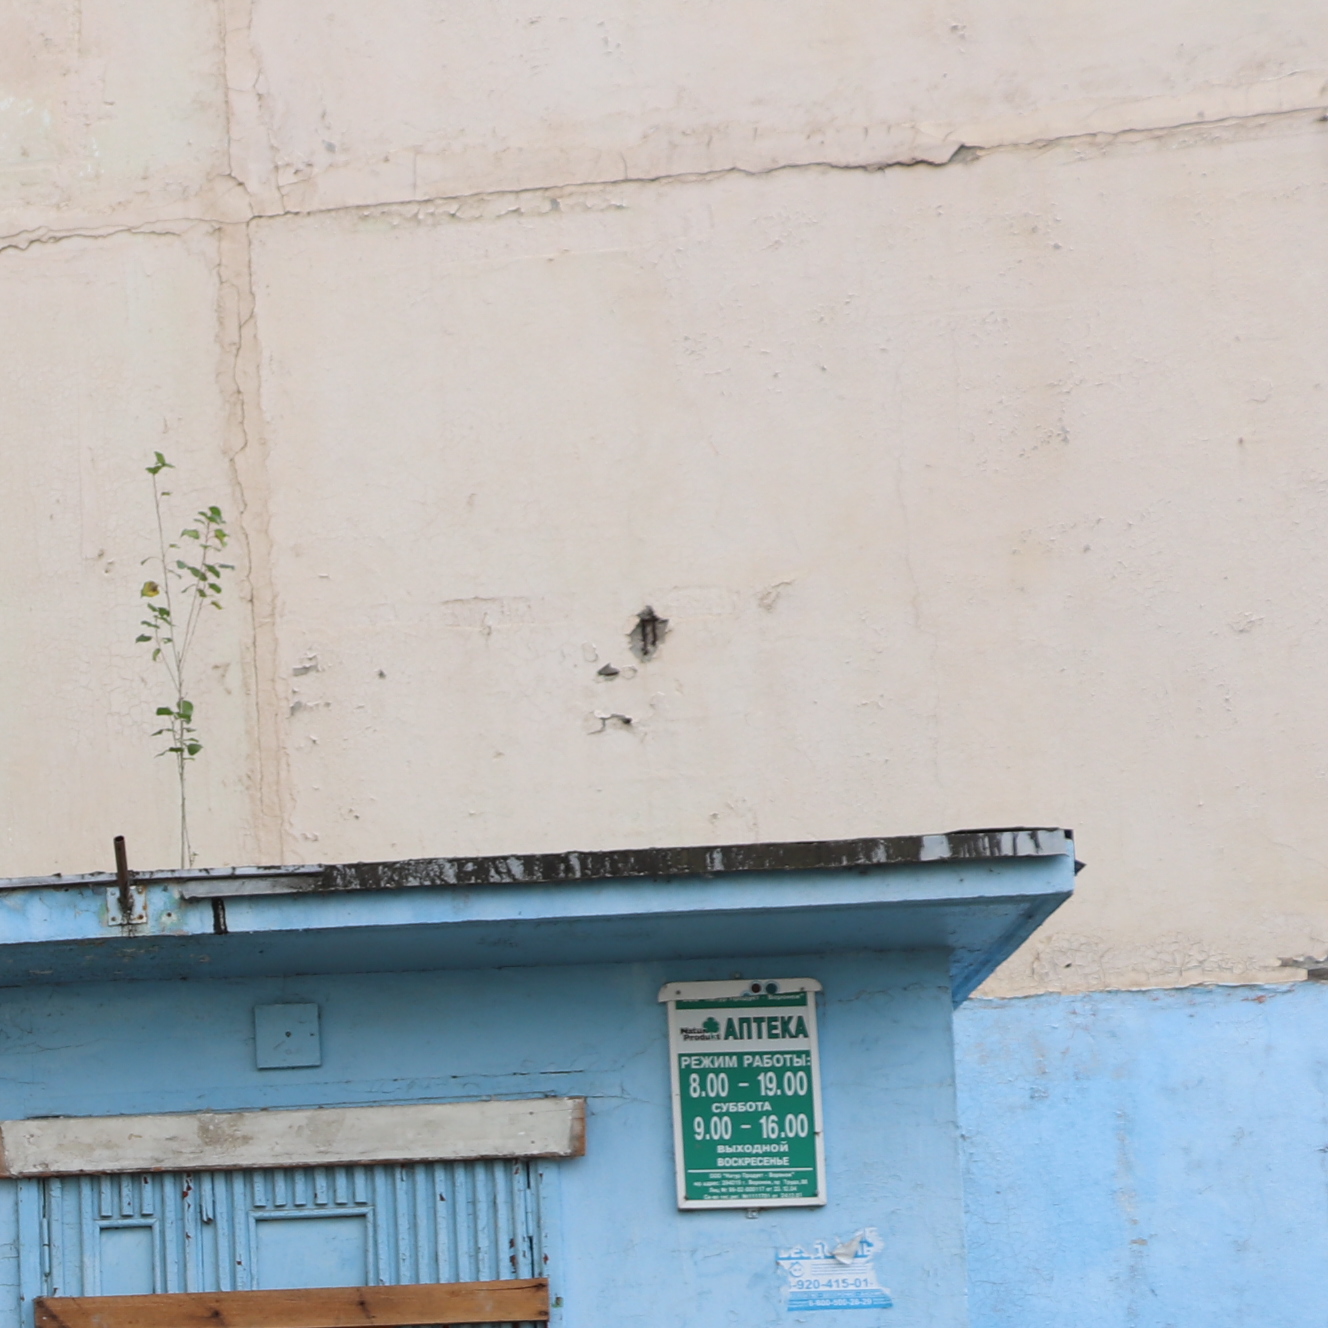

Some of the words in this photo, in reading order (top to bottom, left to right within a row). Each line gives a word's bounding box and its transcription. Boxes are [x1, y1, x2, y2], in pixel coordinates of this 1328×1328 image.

[724, 1015, 809, 1040] АПТЕКА
[683, 1033, 721, 1041] Produkt
[680, 1056, 738, 1069] РЕЖИМ
[743, 1054, 811, 1068] РАБОТЫ:
[689, 1072, 729, 1098] 8.00
[757, 1071, 808, 1096] 19.00
[711, 1101, 772, 1113] СУББОТА
[693, 1115, 732, 1140] 9.00
[759, 1113, 809, 1139] 16.00
[716, 1140, 789, 1154] ВЫХОДНОЙ
[716, 1157, 790, 1167] ВОСКРЕСЕНЬЕ
